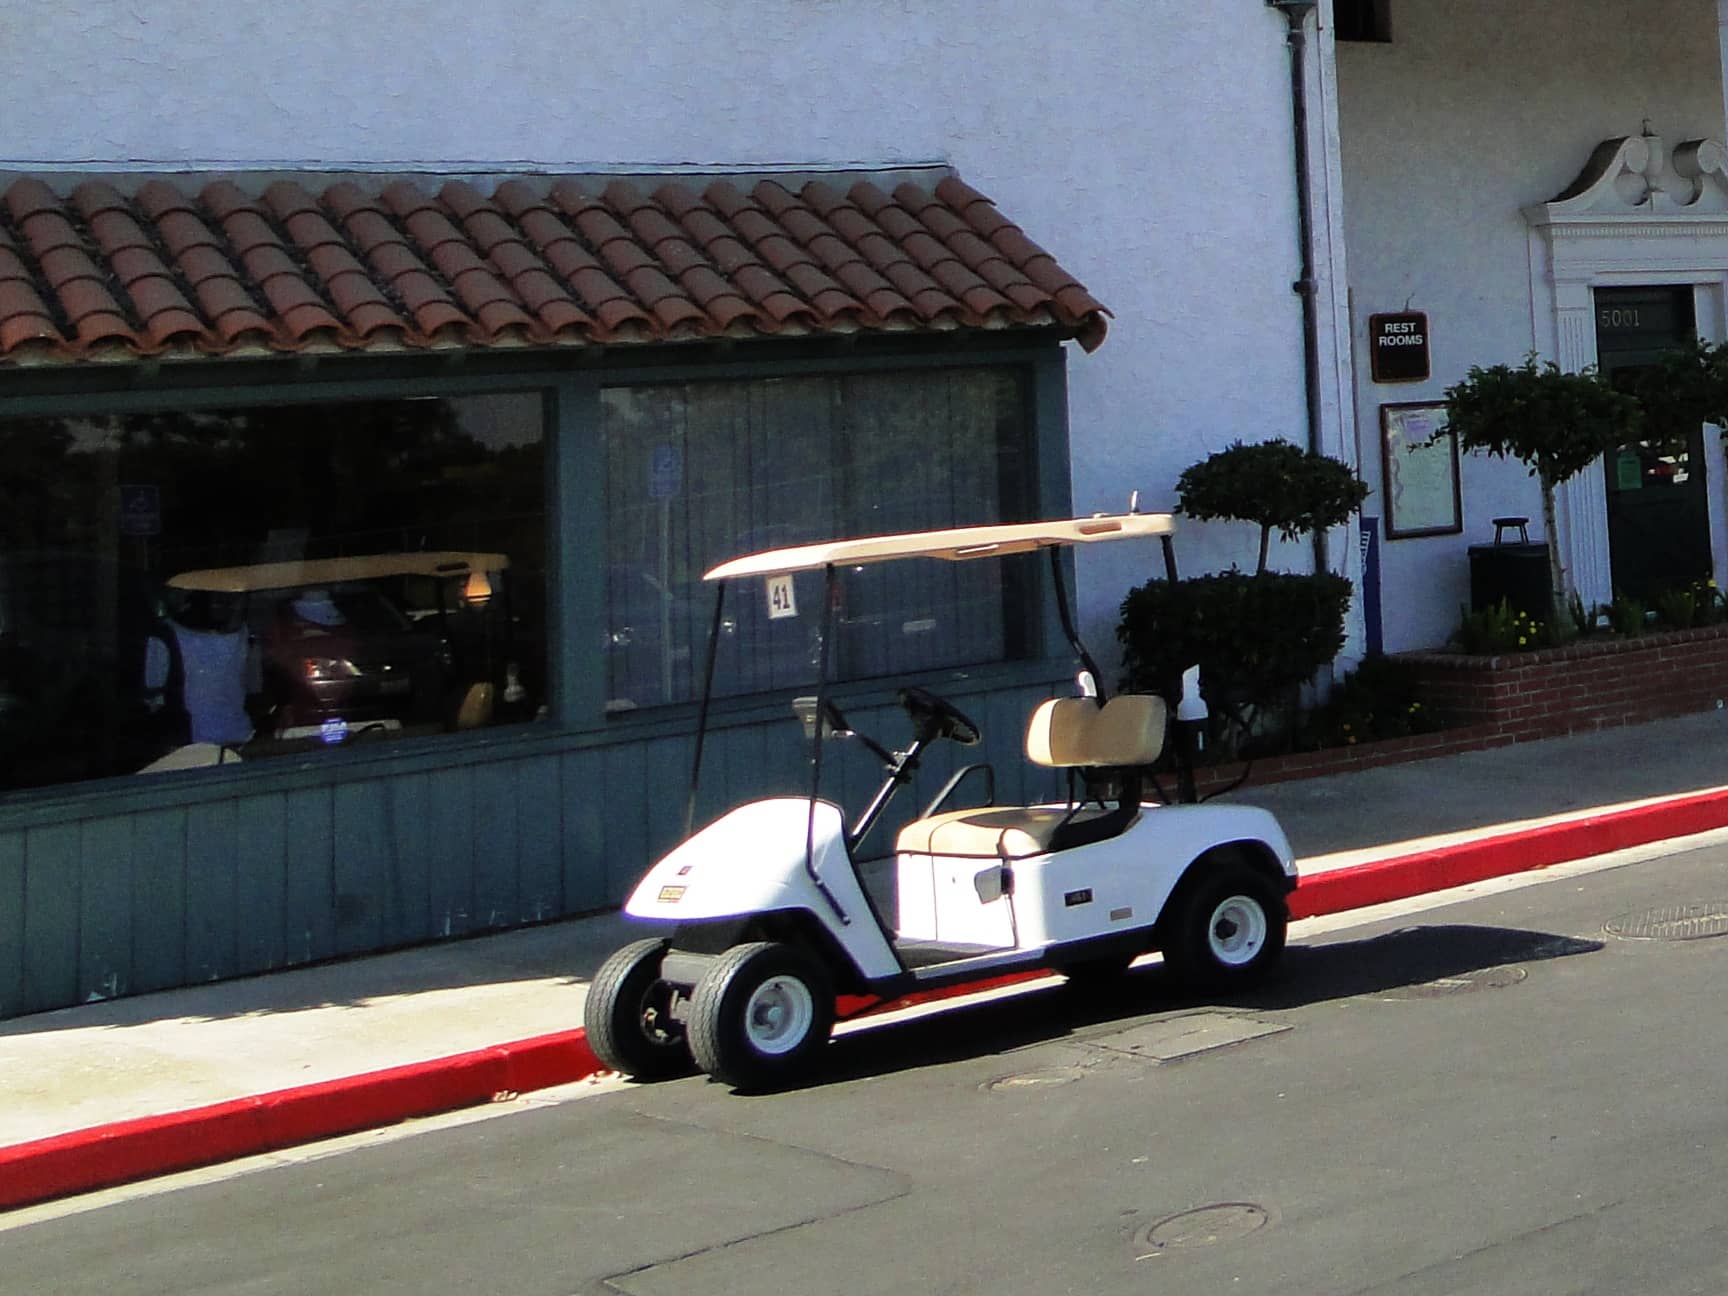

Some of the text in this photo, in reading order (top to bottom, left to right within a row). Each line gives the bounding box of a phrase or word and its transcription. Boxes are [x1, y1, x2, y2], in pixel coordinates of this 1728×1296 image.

[1601, 309, 1640, 328] 5001
[1384, 321, 1416, 333] REST
[1378, 334, 1423, 346] ROOMS
[773, 583, 790, 610] 41
